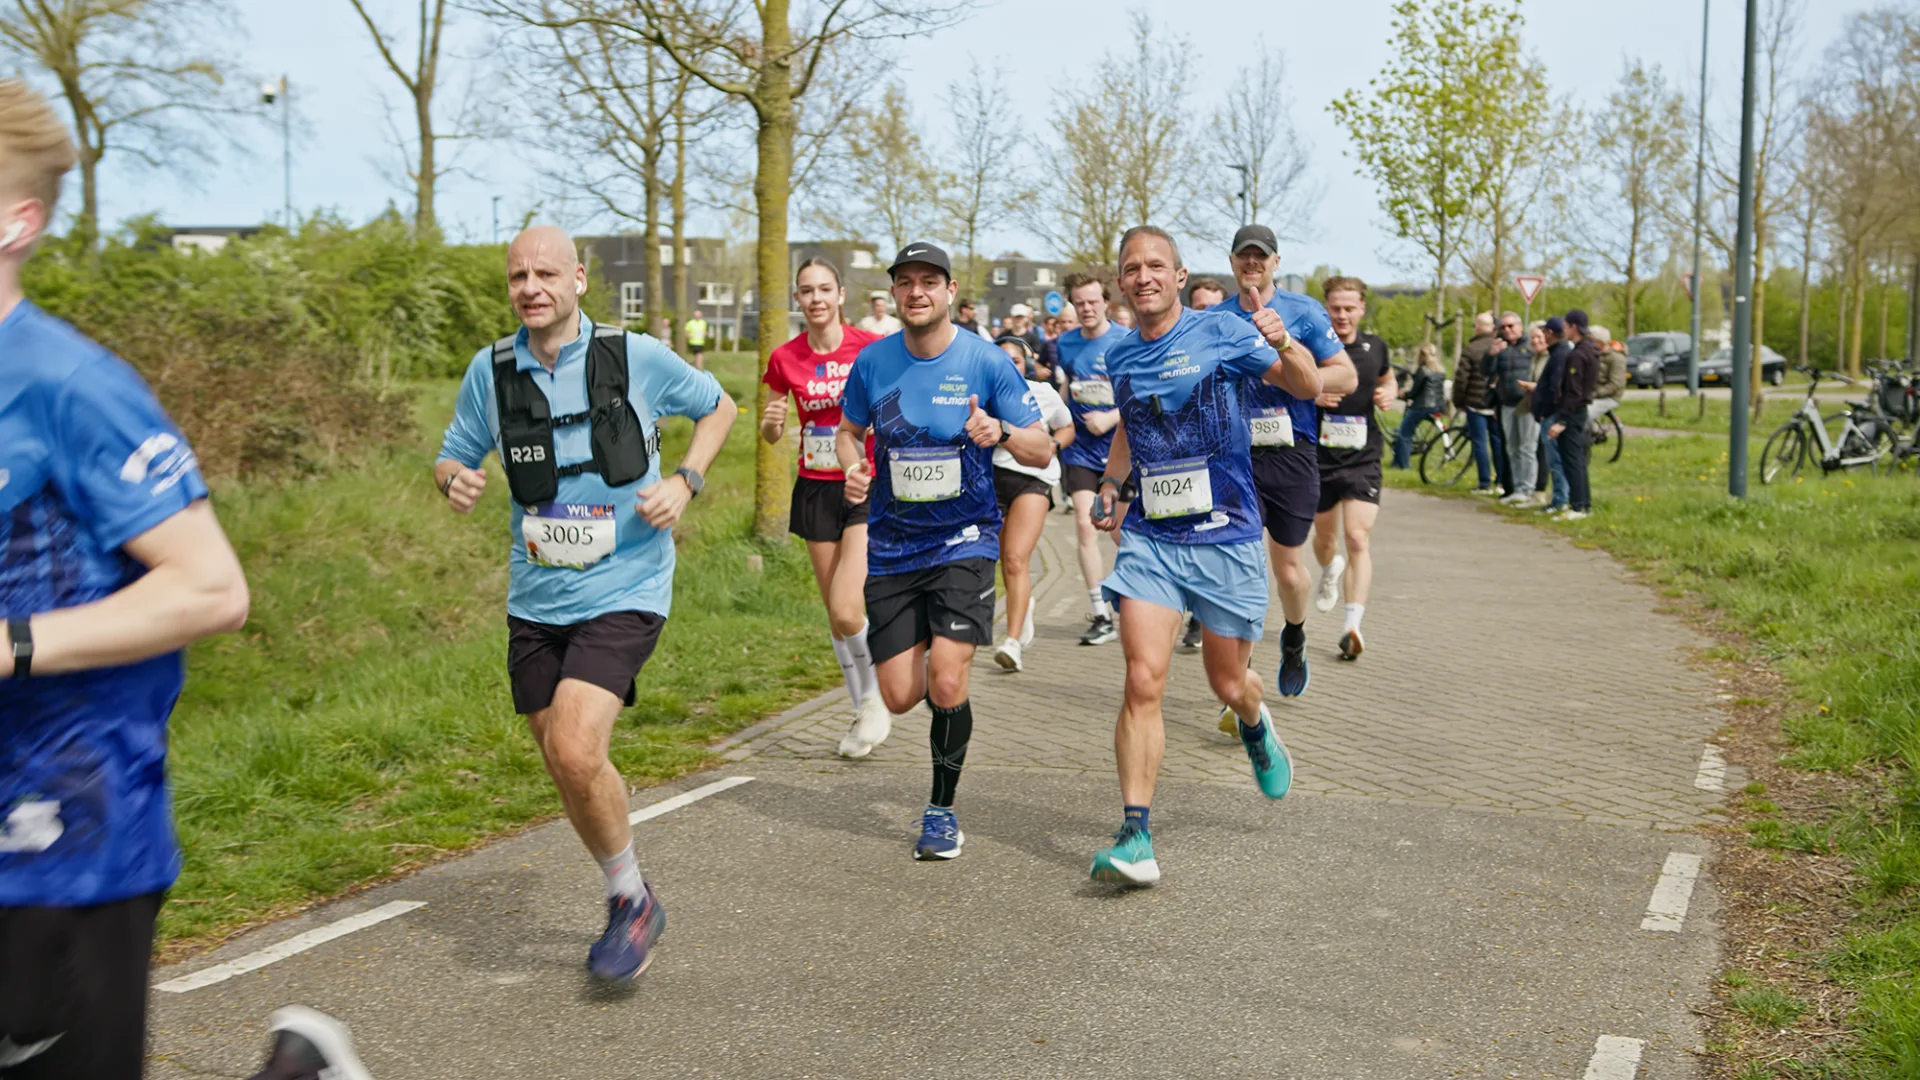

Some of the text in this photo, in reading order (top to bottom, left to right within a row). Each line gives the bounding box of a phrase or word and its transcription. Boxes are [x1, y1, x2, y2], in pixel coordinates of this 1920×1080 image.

[815, 361, 854, 379] #Re
[510, 445, 546, 464] R2B
[815, 439, 837, 453] 23
[903, 465, 944, 481] 4025
[1152, 477, 1193, 497] 4024
[541, 523, 594, 546] 3005
